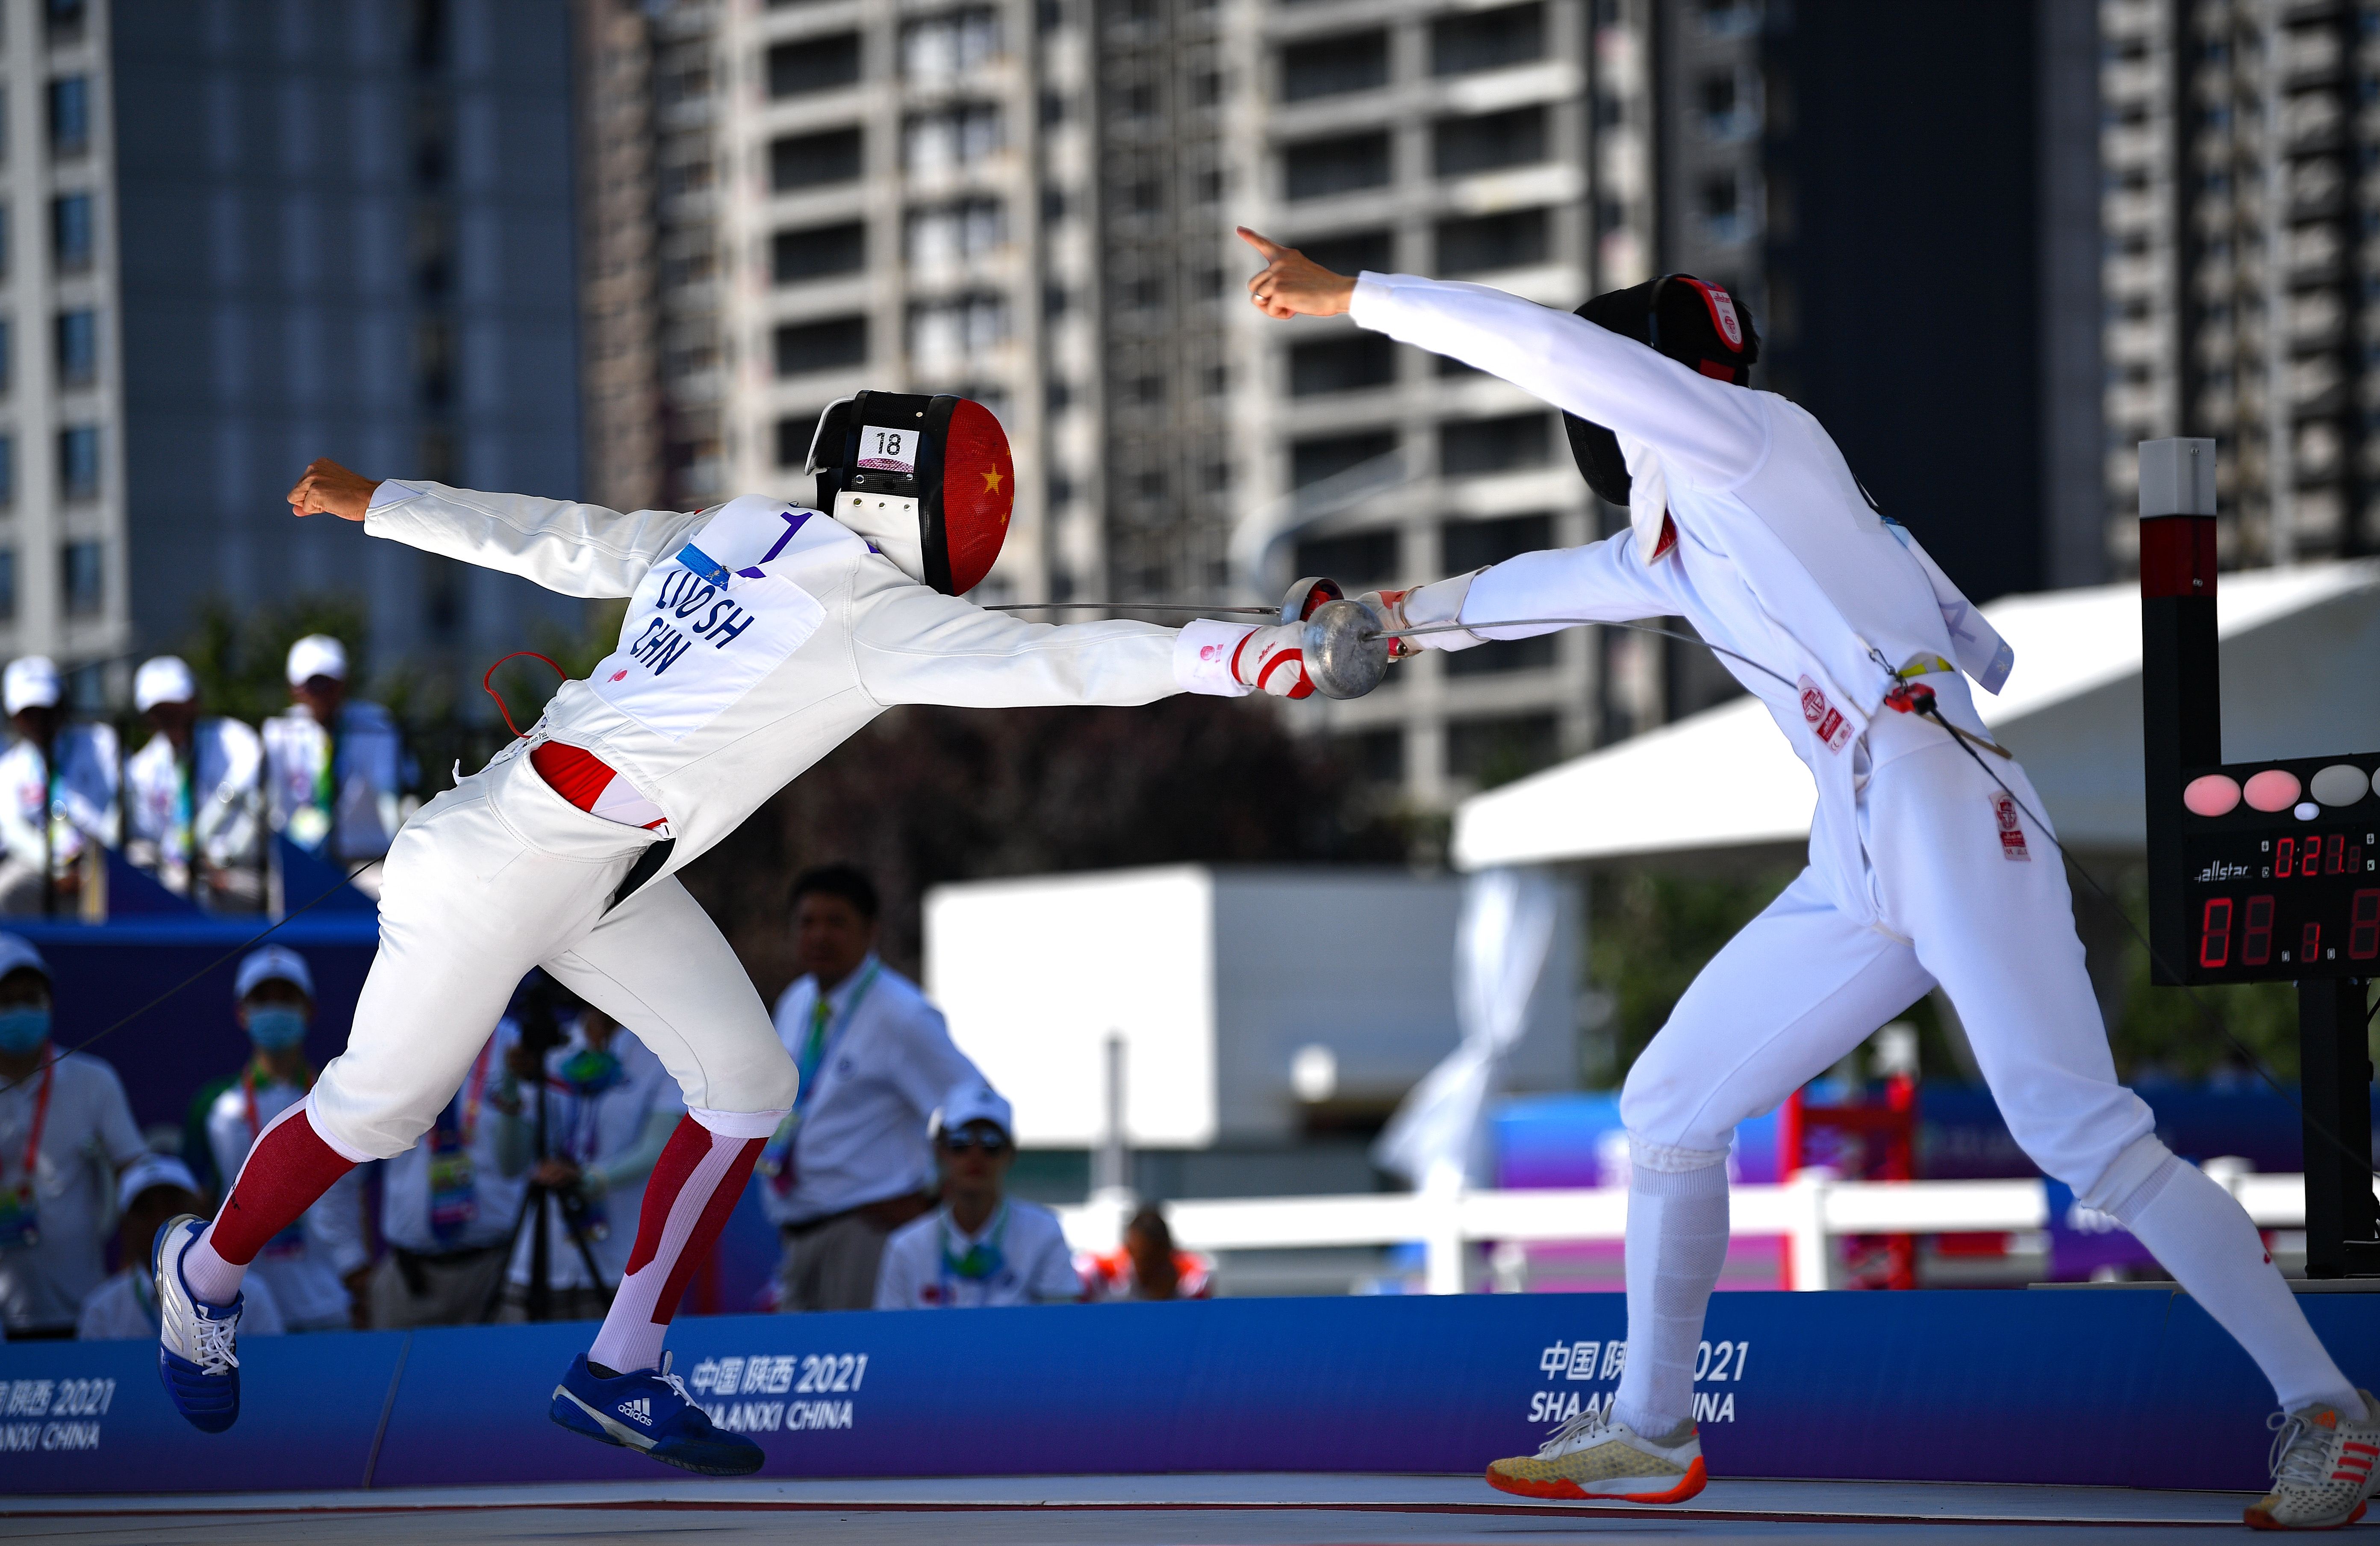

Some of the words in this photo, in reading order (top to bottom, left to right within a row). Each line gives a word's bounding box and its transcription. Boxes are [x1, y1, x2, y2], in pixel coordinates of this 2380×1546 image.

[876, 432, 901, 455] 18
[692, 599, 755, 649] SH
[630, 617, 692, 676] CHN
[2202, 859, 2249, 882] allstar
[794, 1352, 869, 1394] 2021
[1694, 1340, 1750, 1381] 021
[51, 1377, 116, 1416] 2021
[1527, 1391, 1616, 1424] SHAA
[1692, 1392, 1735, 1424] INA
[618, 1404, 653, 1426] adidas
[702, 1400, 786, 1432] AANXI
[785, 1398, 854, 1431] CHINA
[0, 1422, 42, 1452] NXI
[42, 1420, 100, 1451] CHINA
